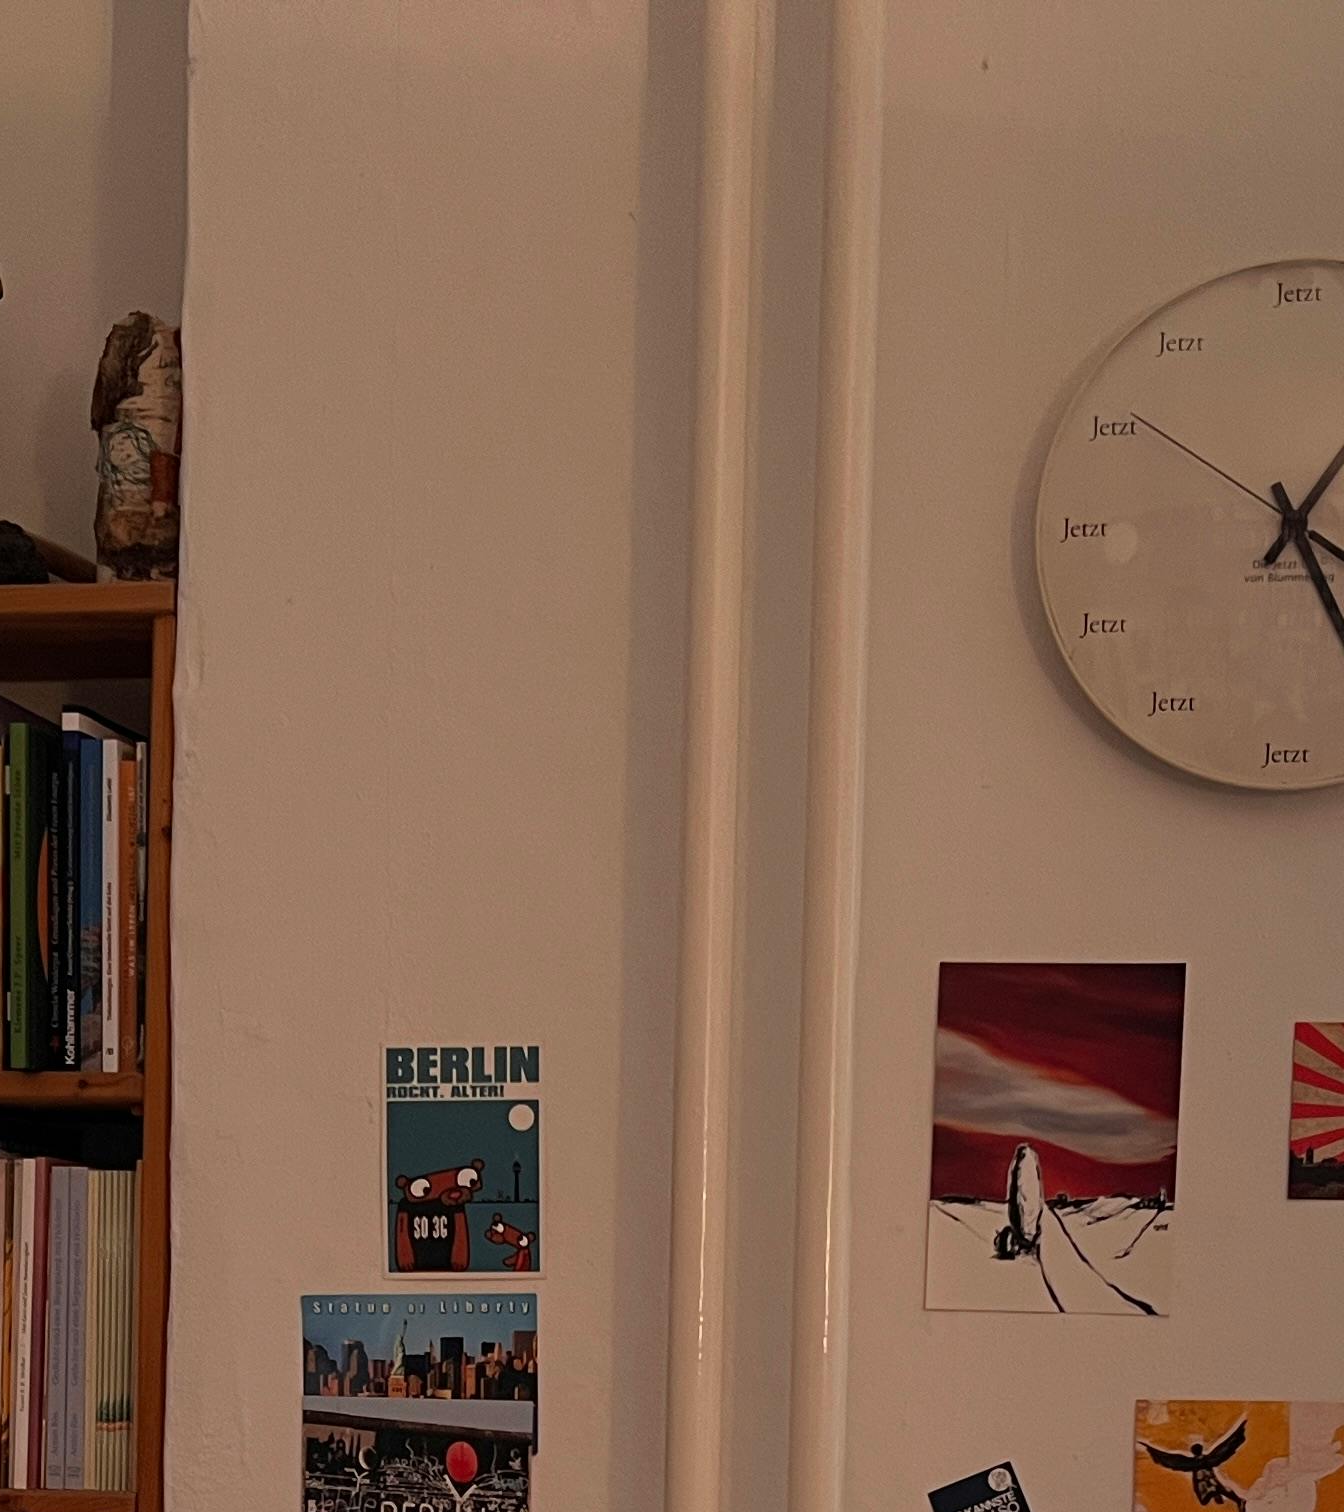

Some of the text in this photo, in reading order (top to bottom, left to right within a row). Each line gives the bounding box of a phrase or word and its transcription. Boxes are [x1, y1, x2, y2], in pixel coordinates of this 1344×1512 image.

[1273, 282, 1322, 308] Jetzt
[1156, 332, 1204, 357] Jetzt
[1090, 415, 1137, 442] Jetzt
[1060, 518, 1107, 543] Jetzt
[1079, 612, 1127, 638] Jetzt
[1148, 691, 1195, 717] Jetzt
[1262, 743, 1309, 768] Jetzt
[65, 989, 76, 1065] Kohlhammer
[386, 1046, 539, 1084] BERLIN
[387, 1086, 504, 1098] ROCKT. ALTER!
[414, 1216, 428, 1239] SO
[312, 1302, 390, 1314] Statue
[441, 1301, 529, 1315] Liberty
